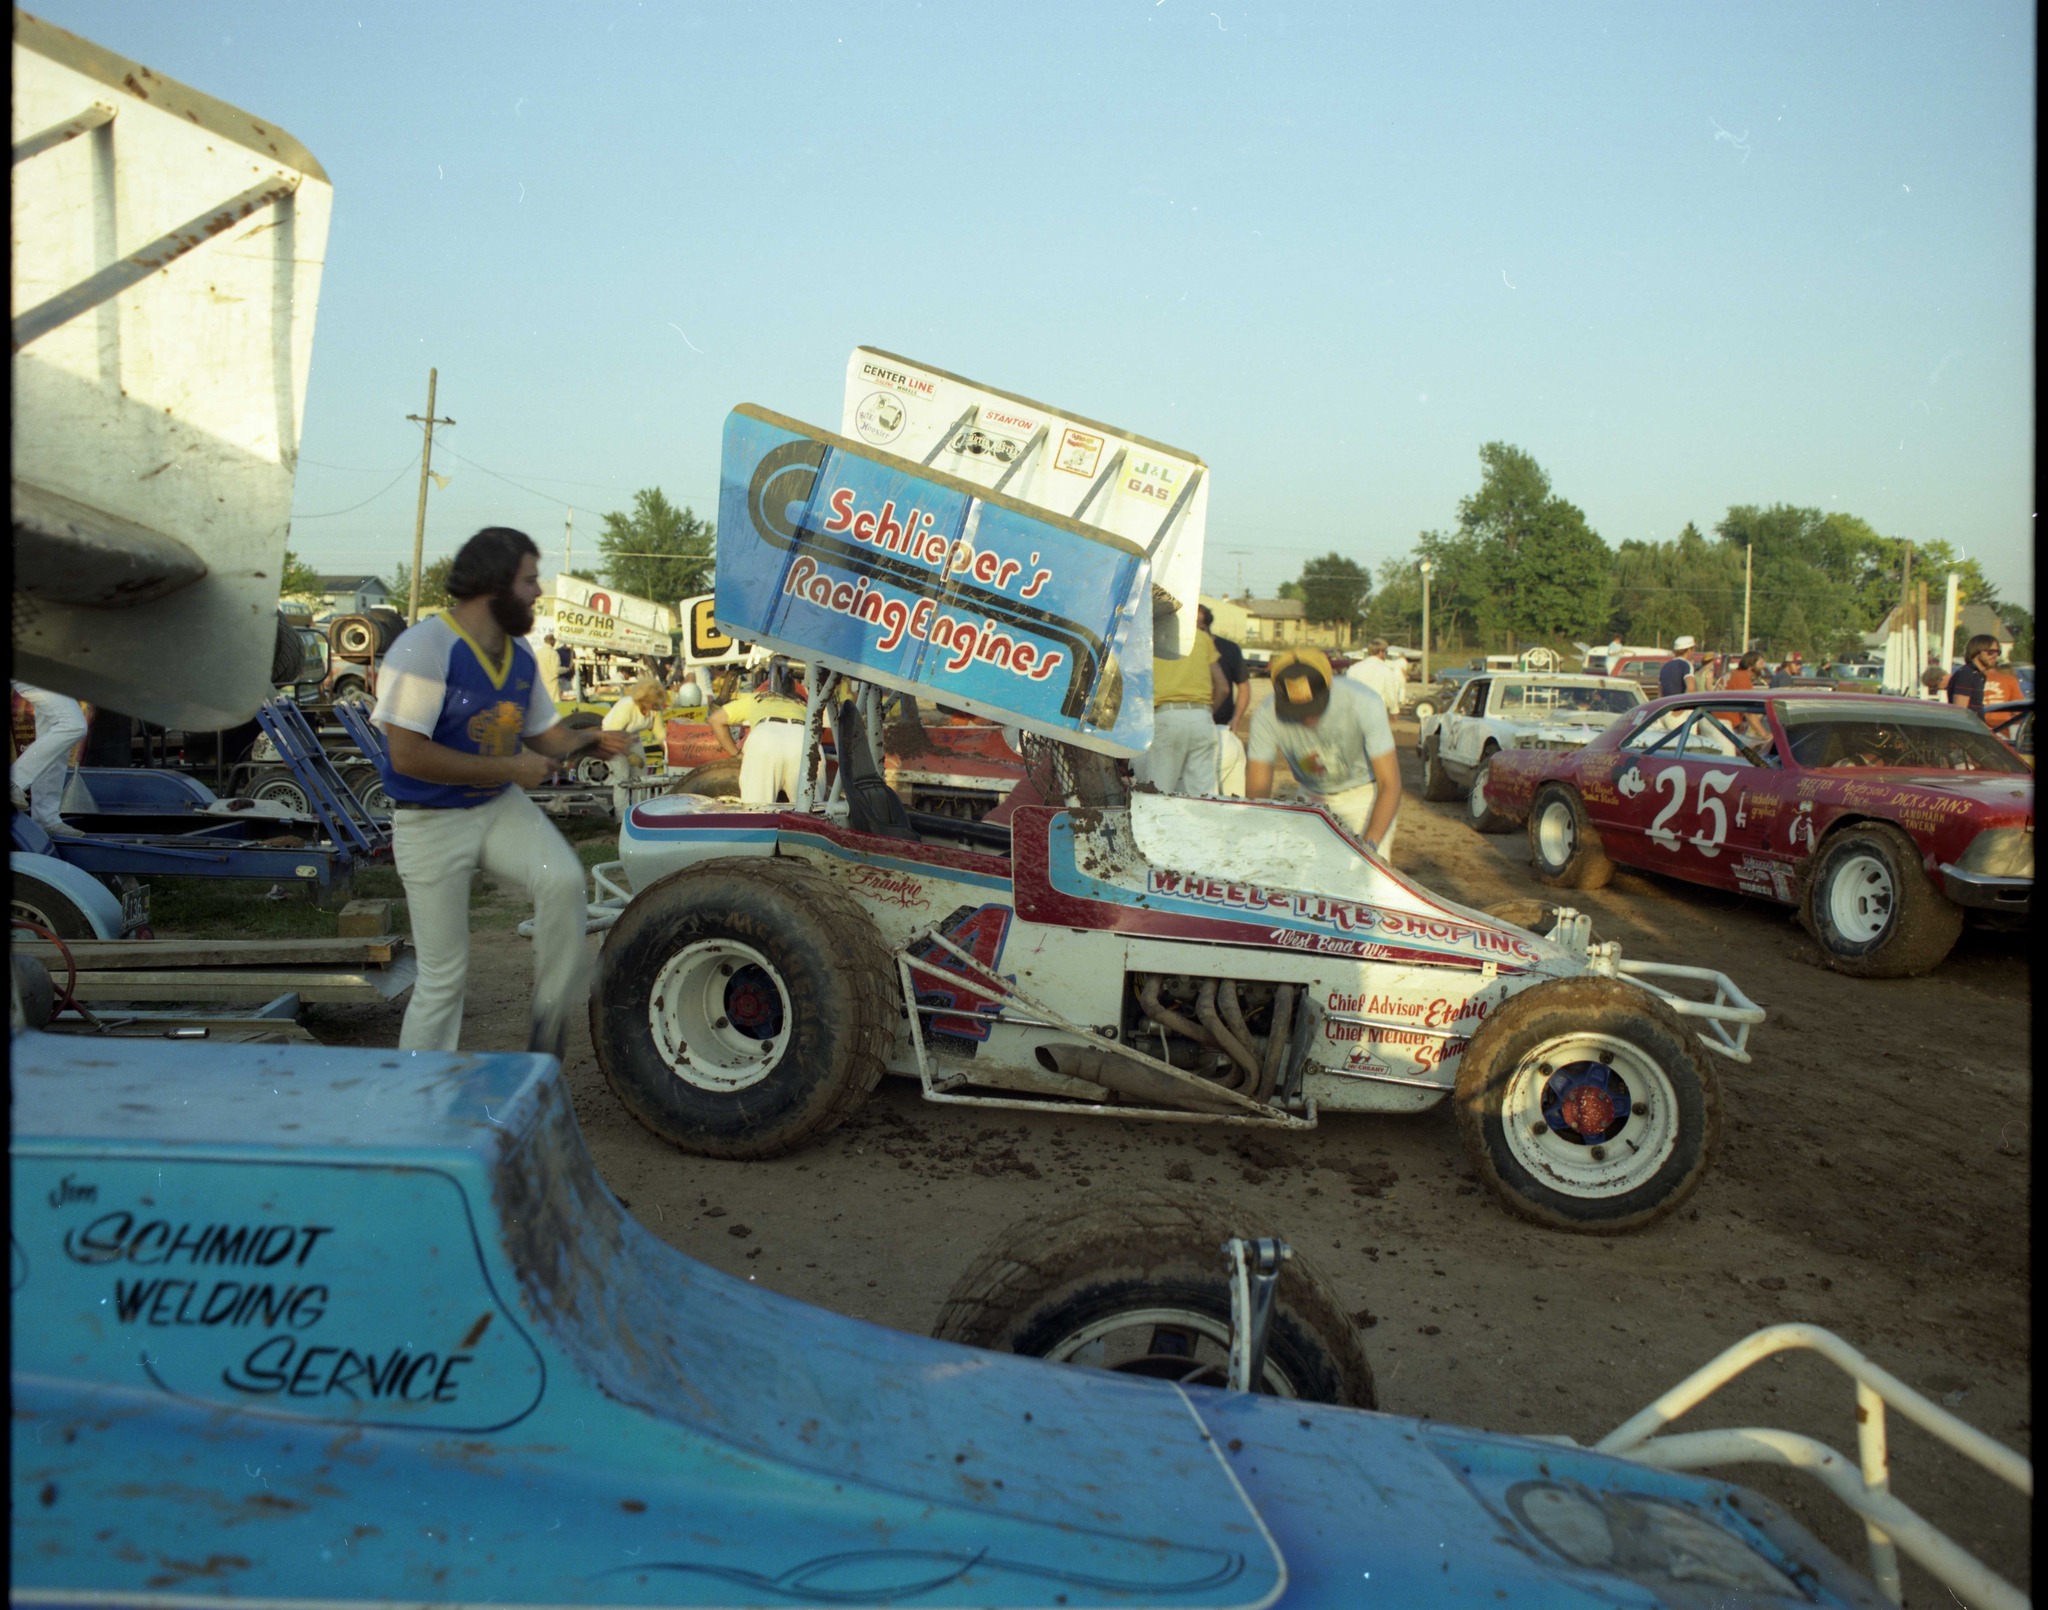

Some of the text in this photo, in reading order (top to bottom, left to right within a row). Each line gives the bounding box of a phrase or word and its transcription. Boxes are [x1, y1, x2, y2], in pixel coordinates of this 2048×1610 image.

[863, 364, 935, 394] CENTER LINE
[985, 411, 1033, 430] STANTON
[1127, 478, 1169, 501] GAS
[824, 487, 1052, 600] Schlieper's
[556, 610, 615, 630] PERSHA
[782, 556, 1063, 681] Racing Engines
[1644, 765, 1739, 859] 25
[1890, 791, 1973, 815] DICK & JAN'S
[1899, 809, 1946, 824] LANDMARK
[1905, 818, 1936, 833] TAVERN
[848, 864, 923, 900] Frankie
[1149, 870, 1266, 909] WHEEL
[1267, 891, 1290, 908] &
[1379, 912, 1470, 944] SHOP
[1474, 929, 1541, 965] INC.
[1270, 927, 1312, 949] West
[1328, 992, 1366, 1013] Chief
[1325, 1019, 1366, 1042] Chief
[49, 1174, 97, 1208] Jim
[65, 1211, 335, 1266] SCHMIDT
[114, 1278, 330, 1327] WELDING
[222, 1334, 475, 1403] SERVICE
